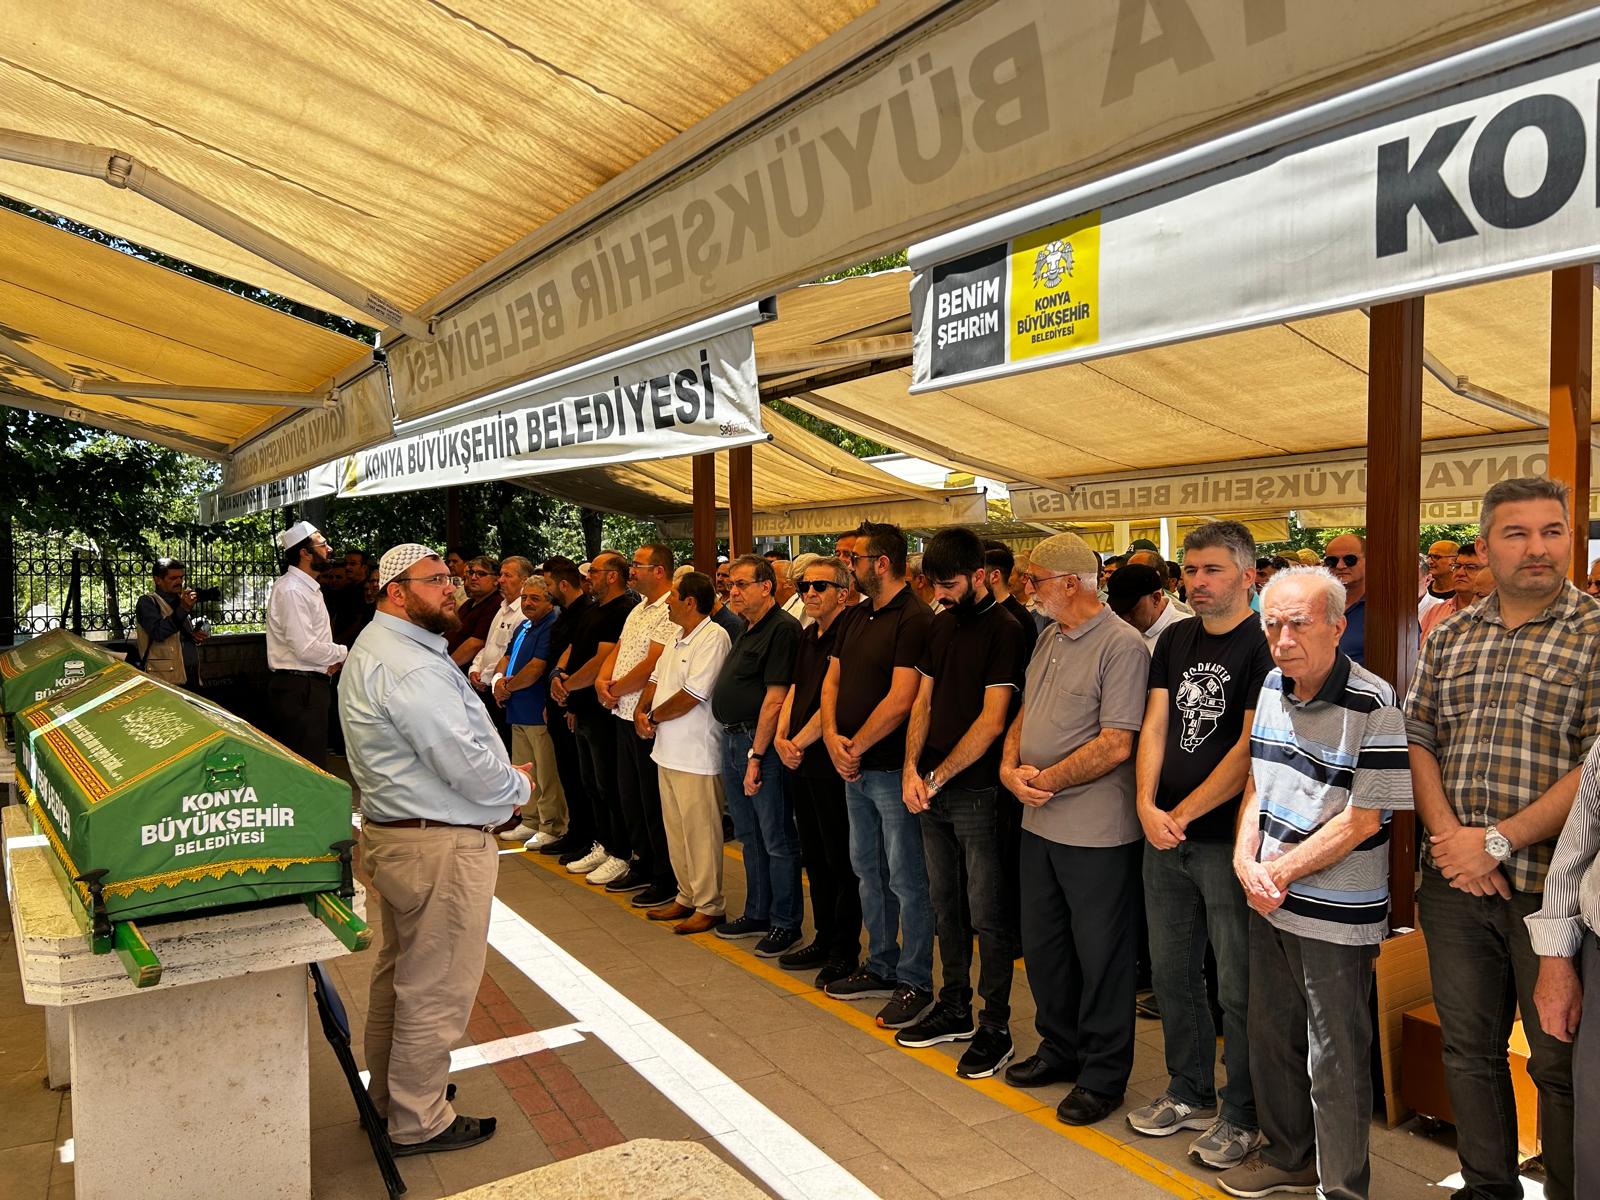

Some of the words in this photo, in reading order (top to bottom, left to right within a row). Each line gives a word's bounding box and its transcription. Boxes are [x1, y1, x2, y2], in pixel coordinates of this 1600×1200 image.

[1376, 93, 1600, 258] KO
[1034, 290, 1071, 312] KONYA
[1017, 302, 1090, 335] BÜYÜKŞEHİR
[1031, 325, 1075, 344] BELEDİYESİ
[365, 450, 404, 481] KONYA
[408, 411, 521, 474] BÜYÜKŞEHİR
[526, 349, 715, 452] BELEDİYESİ
[182, 787, 258, 812] KONYA
[141, 803, 295, 846] BÜYÜKŞEHİR
[174, 828, 265, 856] BELEDİYESİ
